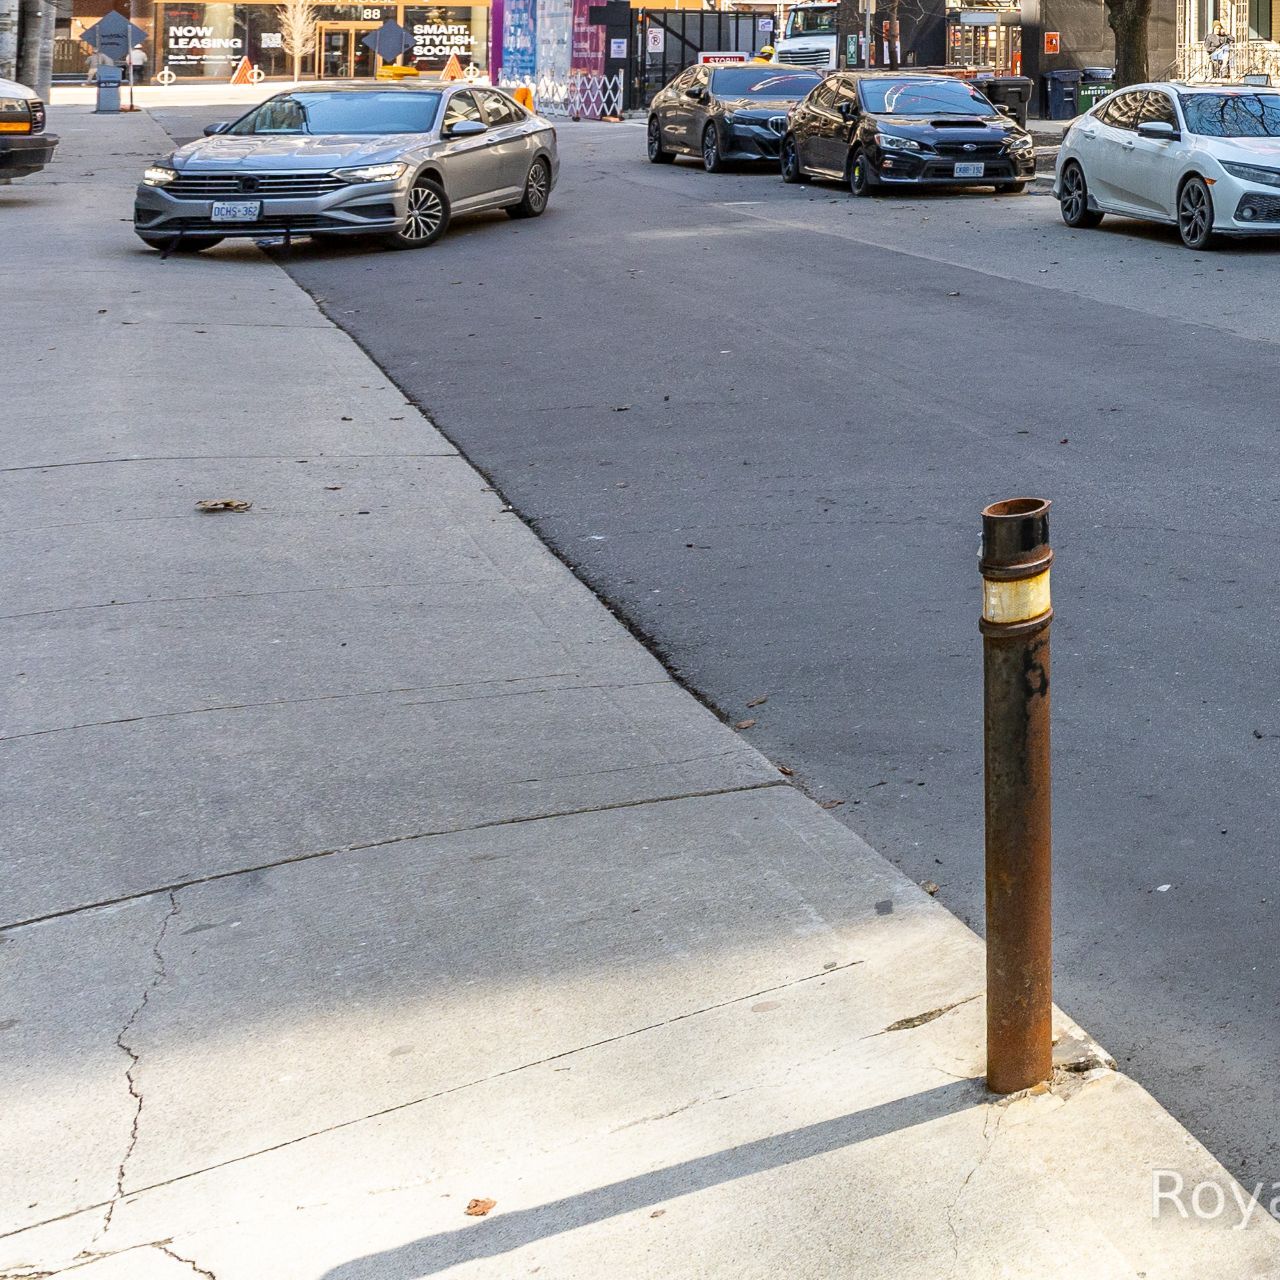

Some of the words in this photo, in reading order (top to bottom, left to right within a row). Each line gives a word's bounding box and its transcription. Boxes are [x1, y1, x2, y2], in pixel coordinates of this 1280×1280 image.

[363, 8, 381, 19] 88
[168, 26, 214, 37] NOW
[413, 24, 469, 35] SMART.
[168, 38, 242, 49] LEASING
[414, 35, 478, 45] STYLISH.
[413, 46, 473, 56] SOCIAL.
